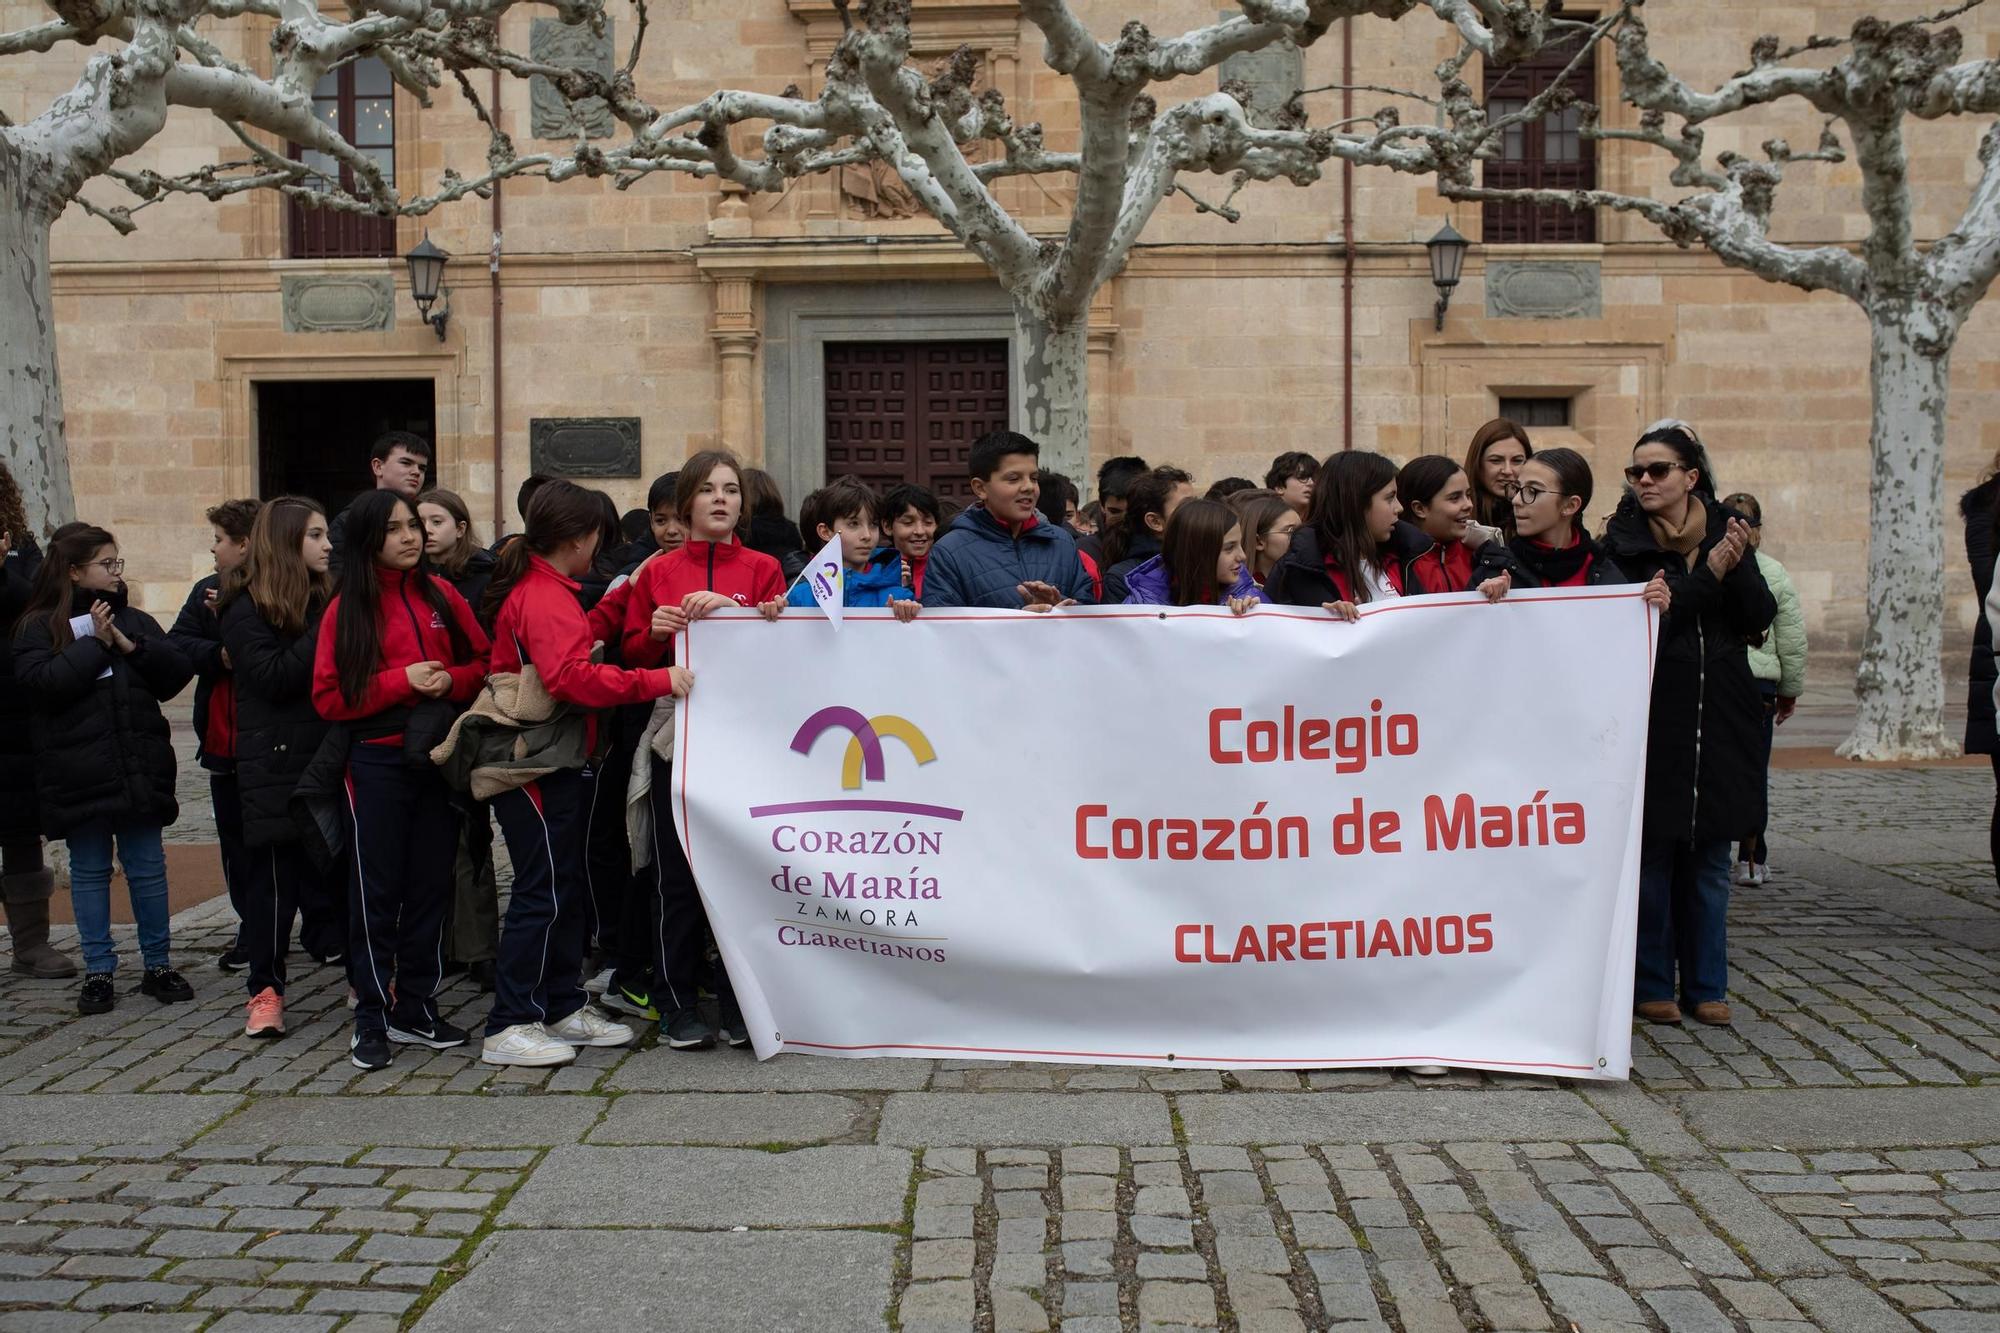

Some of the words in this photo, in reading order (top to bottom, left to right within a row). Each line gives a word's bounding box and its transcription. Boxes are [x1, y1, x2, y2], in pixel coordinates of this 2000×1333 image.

[1209, 698, 1419, 774] Colegio
[772, 821, 943, 855] Corazón
[1075, 801, 1309, 860] Corazón
[1333, 797, 1401, 856] de
[1424, 790, 1585, 851] María
[771, 865, 812, 895] de
[821, 866, 942, 900] María
[796, 902, 918, 926] ZAMORA
[778, 925, 946, 963] Claretianos
[1175, 913, 1493, 963] CLARETIANOS
